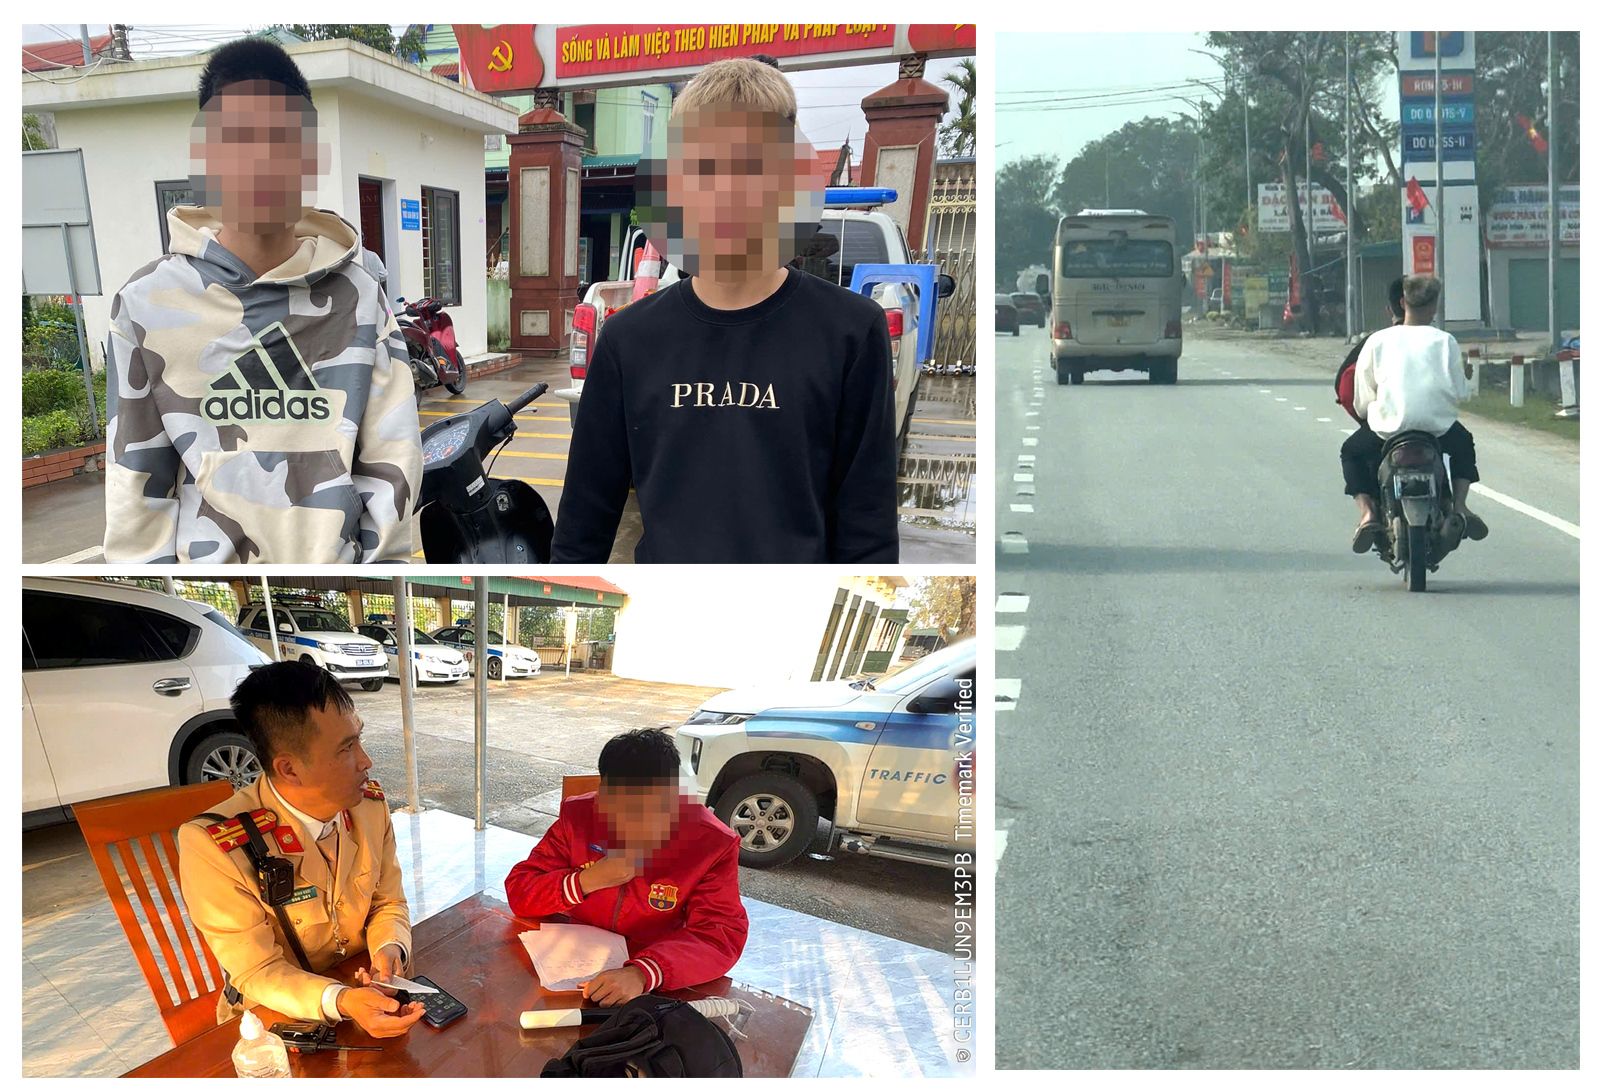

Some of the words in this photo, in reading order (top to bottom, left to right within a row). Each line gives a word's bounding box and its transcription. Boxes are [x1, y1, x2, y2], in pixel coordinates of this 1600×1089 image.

[562, 34, 593, 63] SỐNG
[596, 33, 610, 61] VÀ
[614, 31, 640, 59] LÀM
[644, 27, 670, 59] VIỆC
[674, 26, 705, 52] THEO
[205, 389, 330, 420] adidas
[670, 381, 780, 409] PRADA
[870, 769, 947, 785] TRAFFIC
